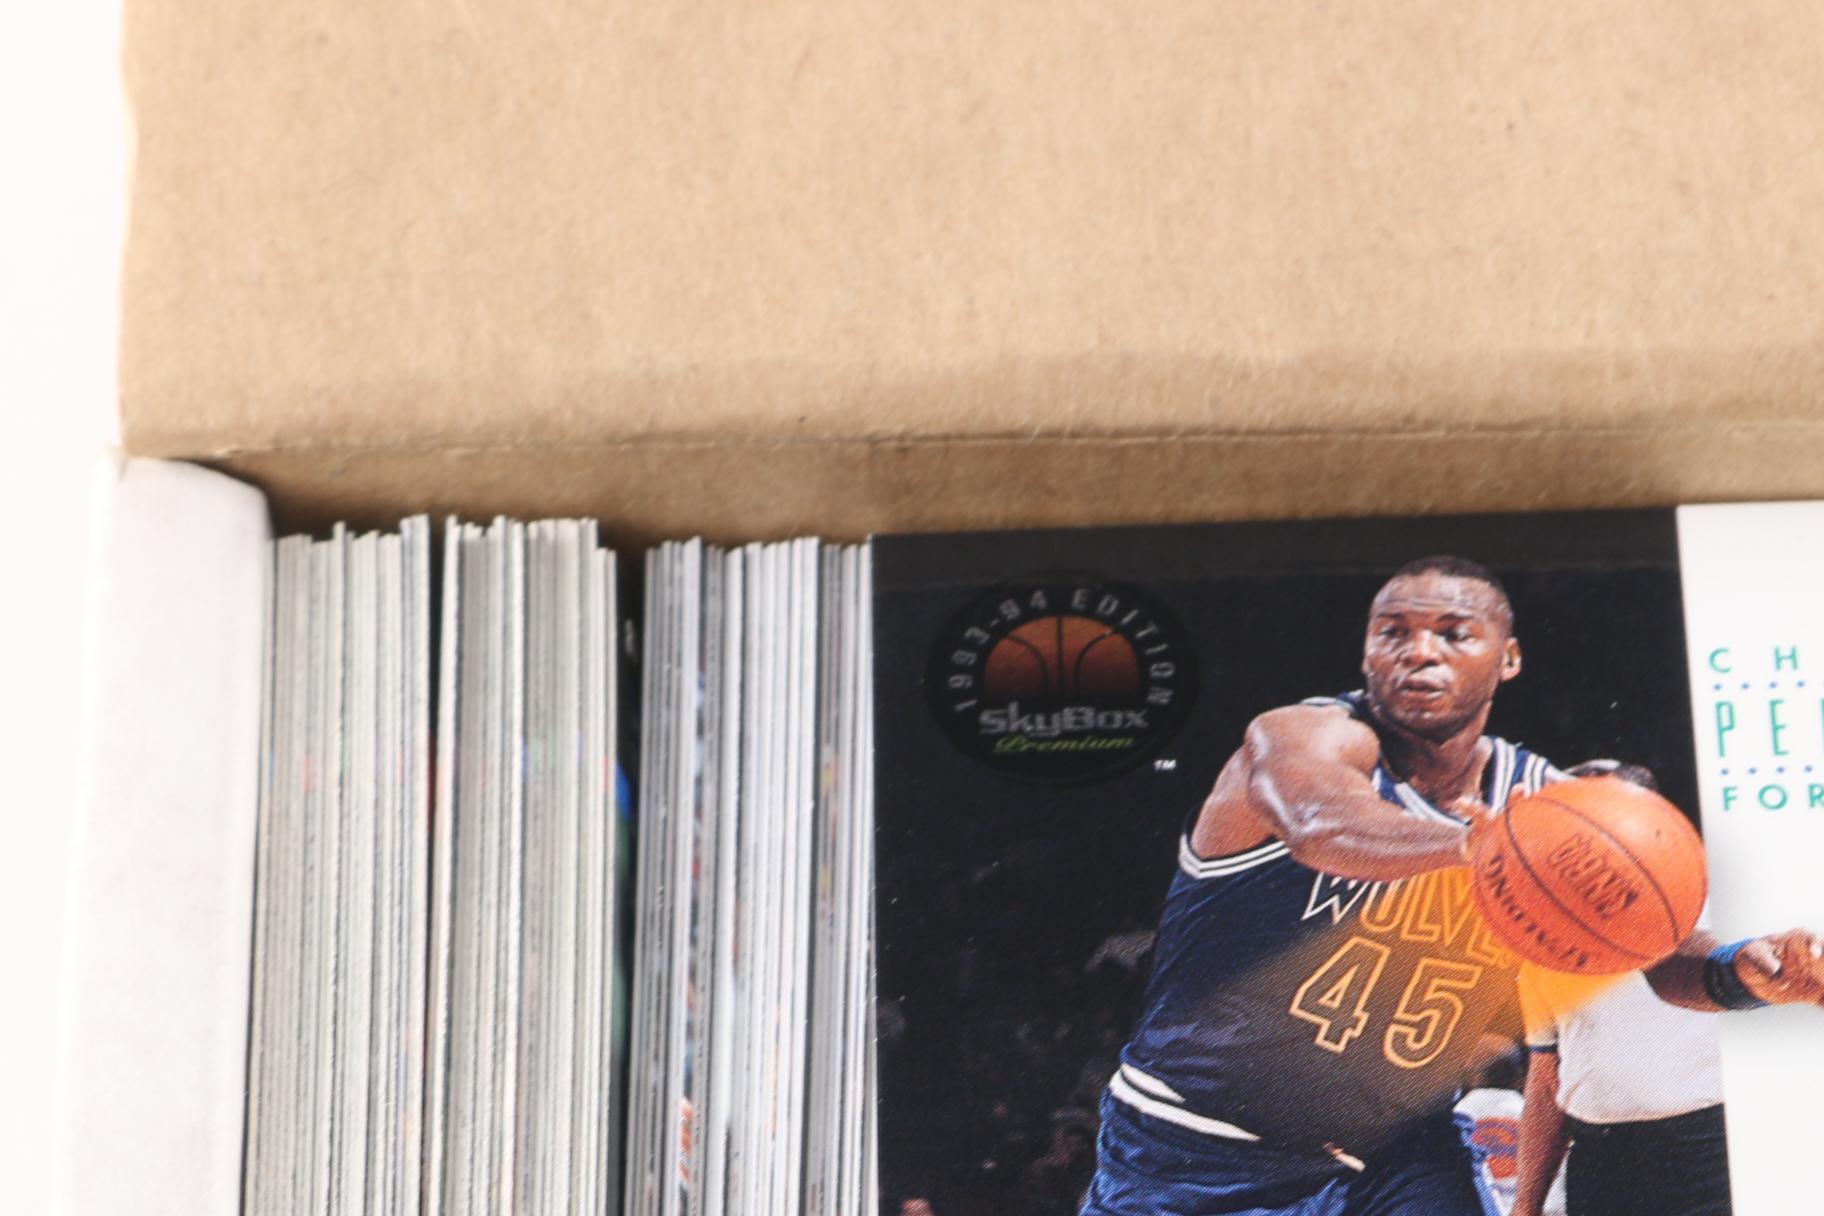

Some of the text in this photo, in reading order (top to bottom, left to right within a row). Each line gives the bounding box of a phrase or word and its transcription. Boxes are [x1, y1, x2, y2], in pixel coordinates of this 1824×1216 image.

[1071, 588, 1175, 705] EDITION
[979, 702, 1149, 736] SkyBox
[992, 735, 1136, 754] Premium
[1301, 866, 1508, 967] WOLVE
[1289, 937, 1482, 1069] 45
